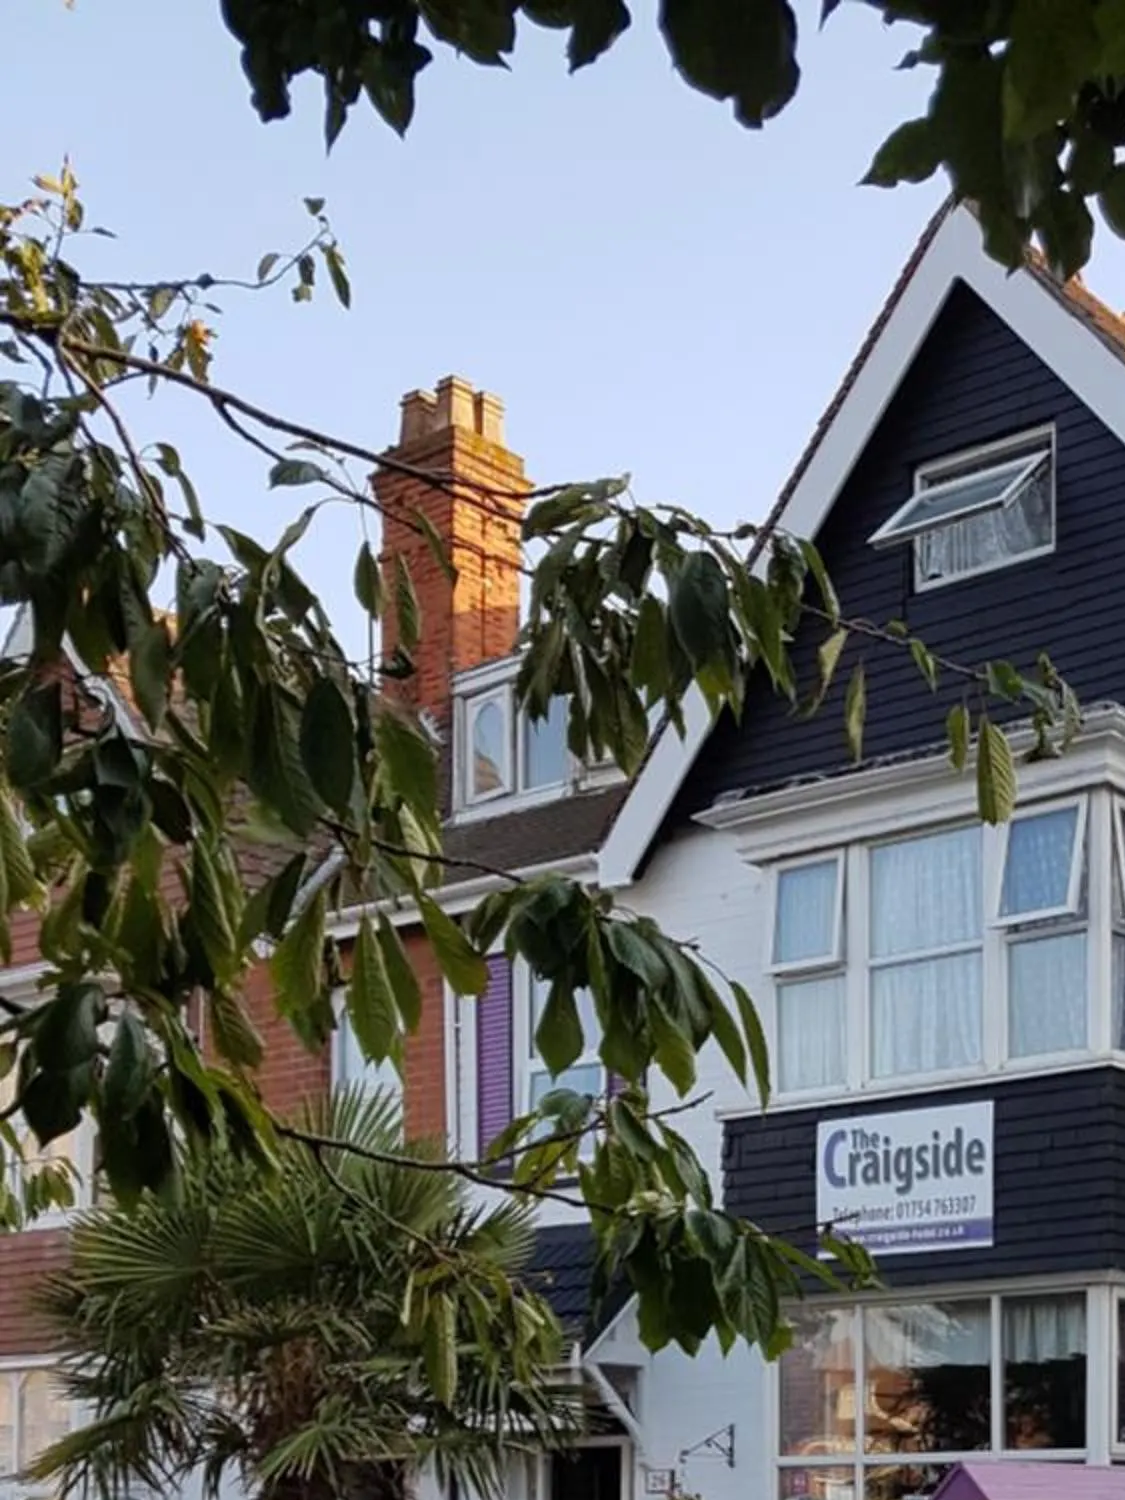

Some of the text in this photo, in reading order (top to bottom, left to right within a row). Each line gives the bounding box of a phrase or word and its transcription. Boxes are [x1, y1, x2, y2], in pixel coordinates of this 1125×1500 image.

[851, 1128, 880, 1149] The
[823, 1127, 985, 1195] Craigside
[896, 1200, 932, 1219] 01754
[934, 1195, 976, 1215] 763307
